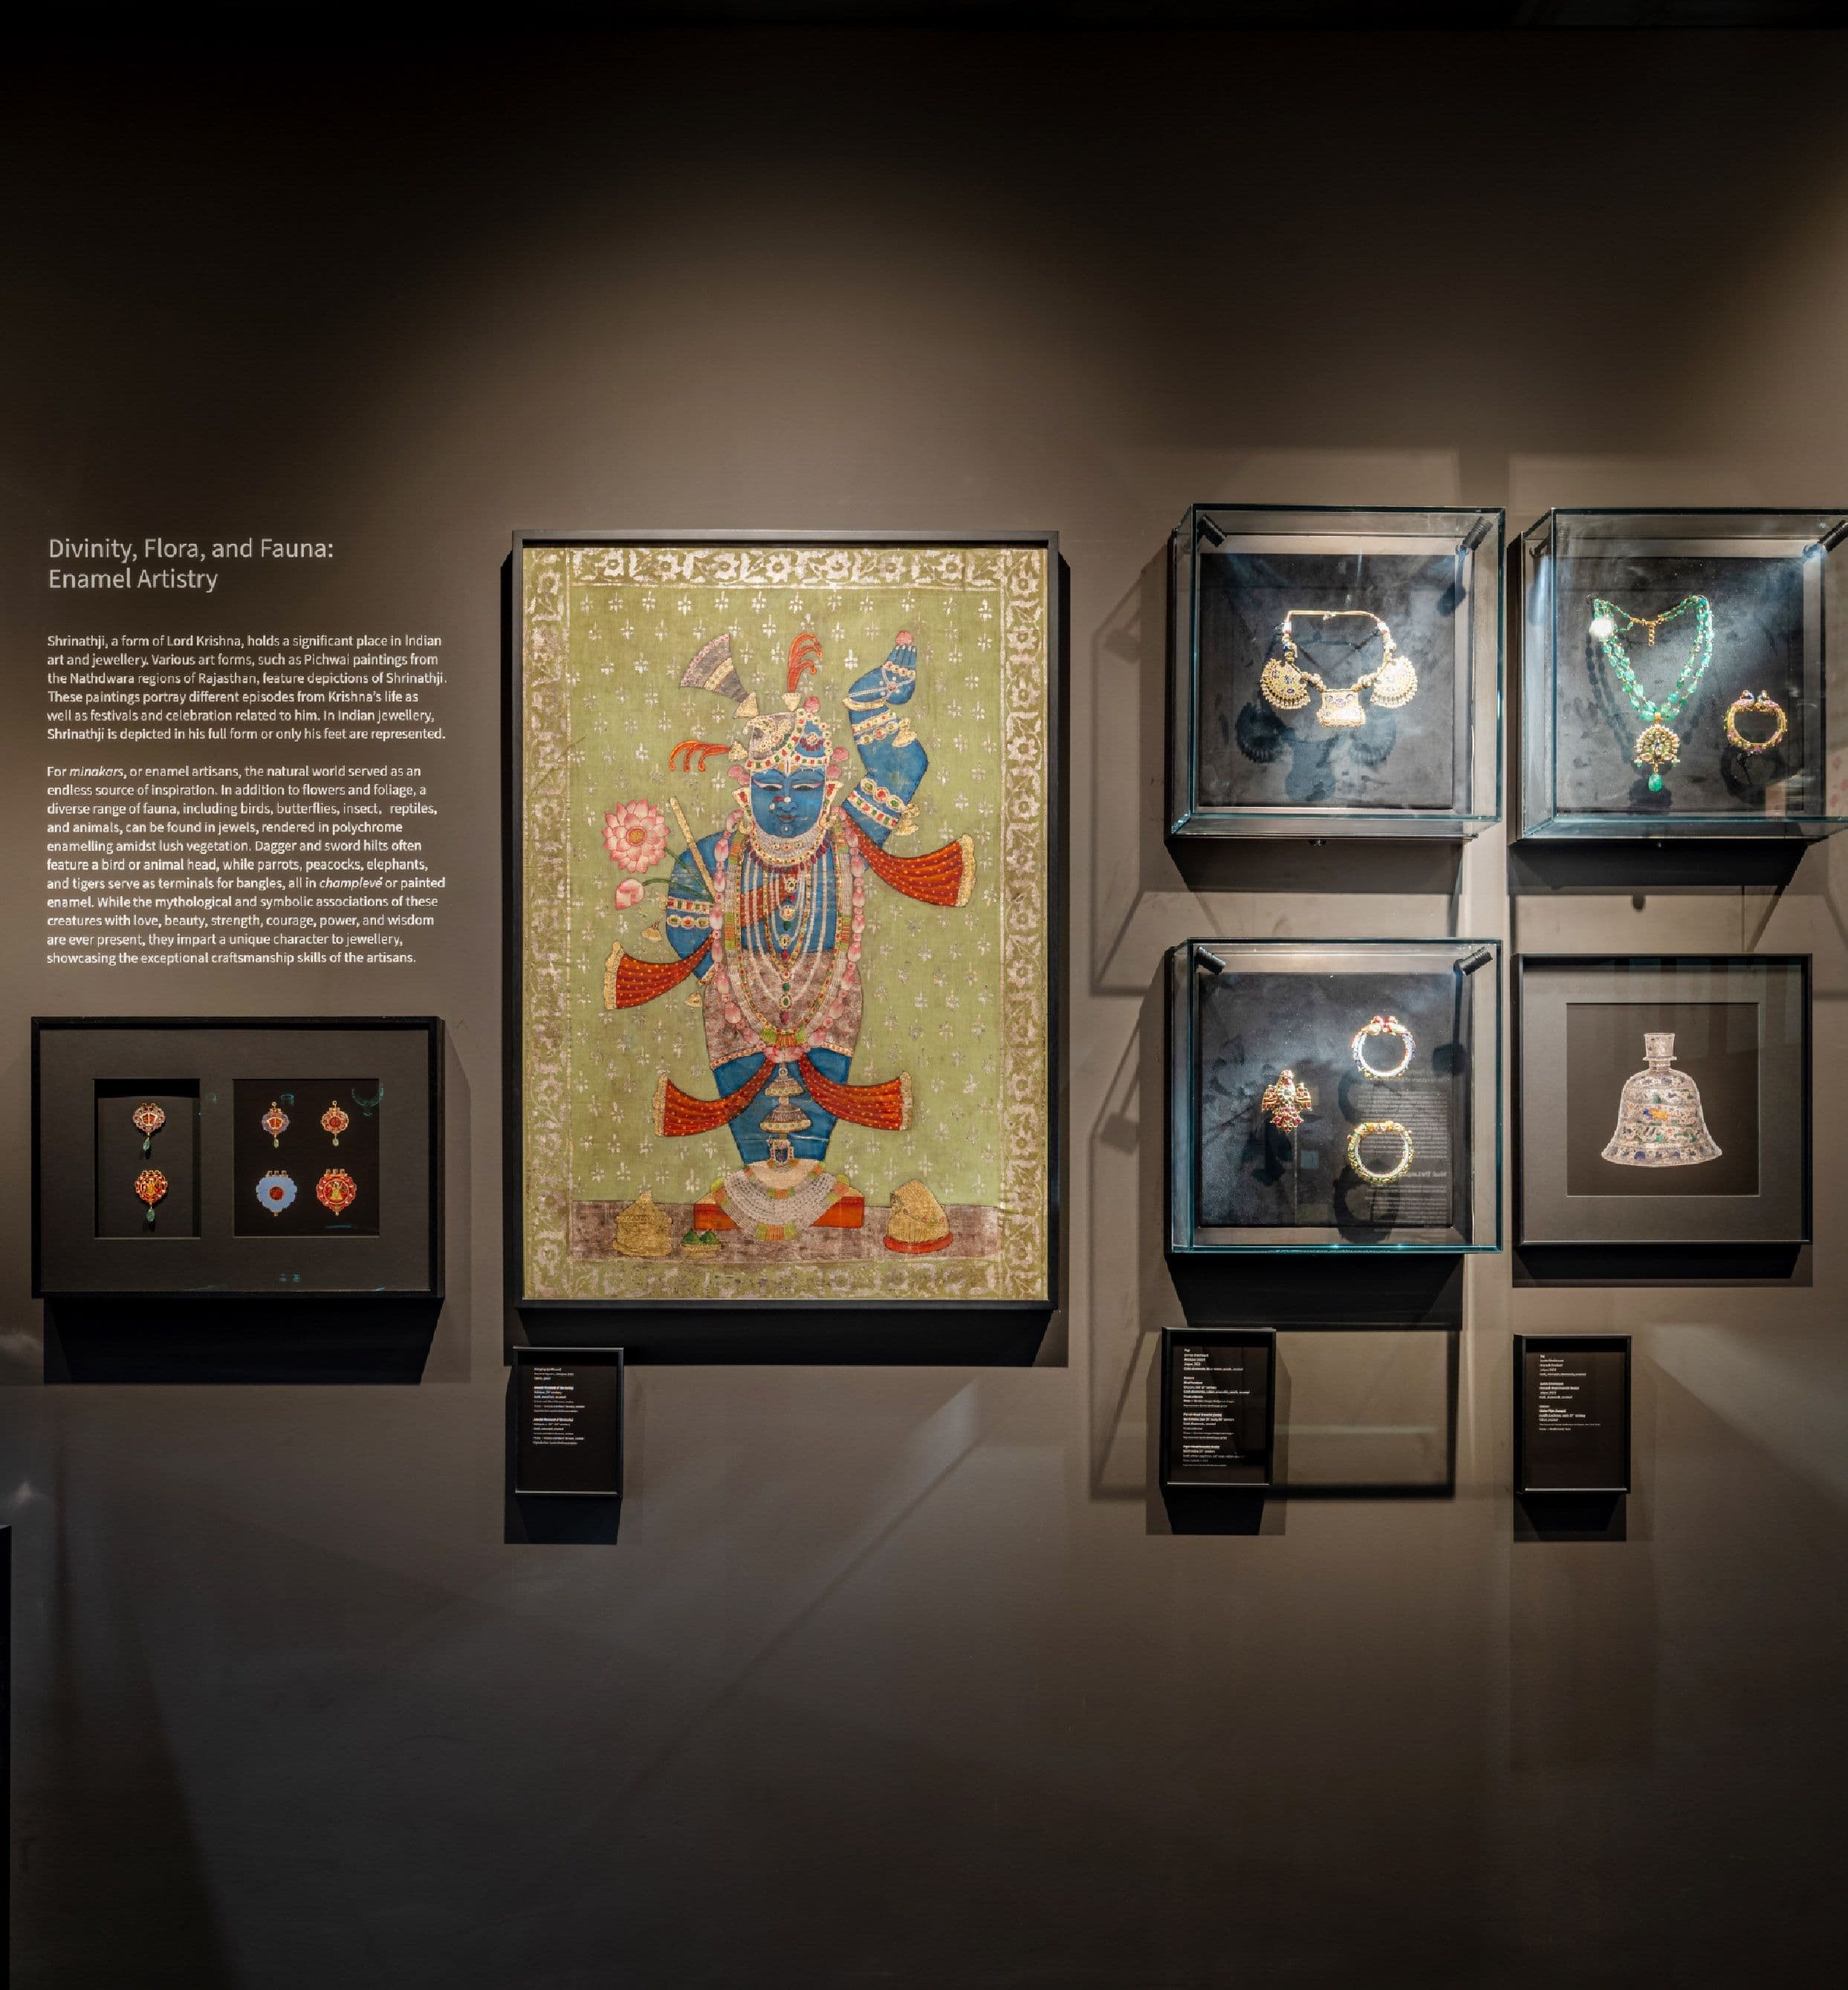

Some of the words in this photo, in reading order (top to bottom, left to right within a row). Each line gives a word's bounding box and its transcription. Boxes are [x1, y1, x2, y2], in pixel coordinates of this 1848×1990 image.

[49, 537, 137, 564] Divinity,
[144, 537, 206, 563] Flora,
[211, 537, 253, 559] and
[261, 538, 334, 560] Fauna:
[49, 566, 132, 589] Enamel
[136, 567, 219, 594] Artistry
[47, 635, 108, 650] Shrinathji,
[111, 638, 119, 646] a
[120, 635, 149, 646] form
[152, 635, 166, 646] of
[166, 635, 194, 646] Lord
[195, 635, 244, 649] Krishna,
[247, 634, 280, 646] holds
[282, 638, 290, 646] a
[292, 634, 354, 650] significant
[356, 634, 388, 649] place
[389, 635, 402, 646] in
[405, 633, 443, 646] Indian
[47, 671, 68, 684] the
[70, 671, 134, 684] Nathdwara
[137, 672, 181, 687] regions
[183, 671, 197, 684] of
[198, 671, 260, 687] Rajasthan,
[262, 671, 305, 684] feature
[306, 671, 369, 687] depictions
[371, 671, 384, 684] of
[386, 671, 447, 687] Shrinathji.
[46, 709, 73, 722] well
[74, 712, 88, 722] as
[90, 709, 139, 722] festivals
[140, 709, 163, 722] and
[165, 708, 233, 722] celebration
[235, 708, 276, 722] related
[279, 710, 292, 722] to
[294, 708, 321, 722] him.
[323, 710, 335, 722] In
[338, 708, 375, 722] Indian
[376, 708, 435, 725] jewellery,
[47, 727, 105, 742] Shrinathji
[107, 727, 118, 740] is
[119, 727, 172, 742] depicted
[174, 727, 185, 740] in
[188, 727, 206, 740] his
[207, 727, 228, 740] full
[230, 727, 258, 740] form
[261, 730, 275, 739] or
[275, 727, 302, 742] only
[304, 727, 322, 739] his
[323, 727, 348, 739] feet
[348, 730, 369, 740] are
[370, 727, 446, 742] represented.
[47, 766, 68, 777] For
[68, 765, 128, 780] minakars,
[129, 767, 143, 777] or
[145, 765, 189, 777] enamel
[192, 765, 242, 780] artisans,
[243, 765, 265, 777] the
[266, 765, 310, 777] natural
[311, 765, 346, 777] world
[348, 765, 388, 777] served
[389, 768, 404, 779] as
[405, 768, 421, 777] an
[47, 783, 93, 796] endless
[94, 786, 134, 796] source
[136, 783, 150, 796] of
[151, 784, 218, 799] inspiration.
[221, 784, 233, 796] In
[234, 783, 285, 796] addition
[287, 784, 300, 796] to
[301, 783, 346, 796] flowers
[347, 783, 371, 796] and
[372, 783, 418, 799] foliage,
[419, 786, 427, 796] a
[47, 801, 91, 814] diverse
[92, 806, 127, 817] range
[129, 801, 142, 814] of
[142, 801, 181, 817] fauna,
[183, 801, 239, 817] including
[240, 801, 275, 816] birds,
[276, 801, 340, 817] butterflies,
[389, 801, 438, 817] reptiles,
[47, 821, 70, 833] and
[72, 821, 123, 835] animals,
[126, 823, 147, 833] can
[149, 821, 165, 833] be
[166, 820, 202, 833] found
[204, 821, 216, 833] in
[217, 821, 260, 836] jewels,
[262, 821, 315, 833] rendered
[318, 821, 330, 833] in
[331, 820, 403, 836] polychrome
[46, 839, 114, 855] enamelling
[115, 839, 157, 852] amidst
[158, 839, 184, 852] lush
[186, 840, 252, 855] vegetation.
[255, 840, 298, 855] Dagger
[299, 839, 322, 852] and
[323, 839, 361, 852] sword
[363, 839, 389, 852] hilts
[391, 838, 422, 852] often
[46, 858, 89, 871] feature
[91, 861, 99, 871] a
[101, 858, 125, 871] bird
[128, 861, 141, 871] or
[143, 858, 184, 871] animal
[187, 858, 220, 873] head,
[221, 858, 255, 871] while
[258, 859, 302, 873] parrots,
[305, 858, 364, 873] peacocks,
[366, 857, 429, 873] elephants,
[46, 876, 70, 889] and
[71, 877, 106, 892] tigers
[107, 880, 140, 889] serve
[142, 880, 156, 889] as
[158, 876, 215, 889] terminals
[215, 876, 235, 889] for
[236, 876, 286, 891] bangles,
[288, 876, 302, 889] all
[305, 876, 317, 889] in
[384, 879, 399, 889] or
[401, 876, 446, 891] painted
[47, 915, 103, 926] creatures
[104, 914, 131, 926] with
[133, 914, 162, 928] love,
[163, 914, 209, 929] beauty,
[210, 913, 264, 929] strength,
[265, 916, 317, 929] courage,
[320, 916, 360, 929] power,
[363, 913, 385, 926] and
[386, 913, 435, 926] wisdom
[46, 936, 67, 946] are
[68, 936, 96, 946] ever
[97, 933, 146, 947] present,
[148, 933, 175, 947] they
[176, 933, 217, 947] impart
[218, 936, 226, 946] a
[228, 933, 273, 947] unique
[272, 933, 330, 945] character
[331, 933, 345, 946] to
[344, 933, 403, 947] jewellery,
[46, 952, 117, 967] showcasing
[117, 952, 139, 964] the
[140, 951, 210, 967] exceptional
[211, 951, 295, 967] craftsmanship
[296, 951, 327, 964] skills
[328, 951, 343, 963] of
[343, 951, 364, 963] the
[366, 951, 416, 964] artisans.
